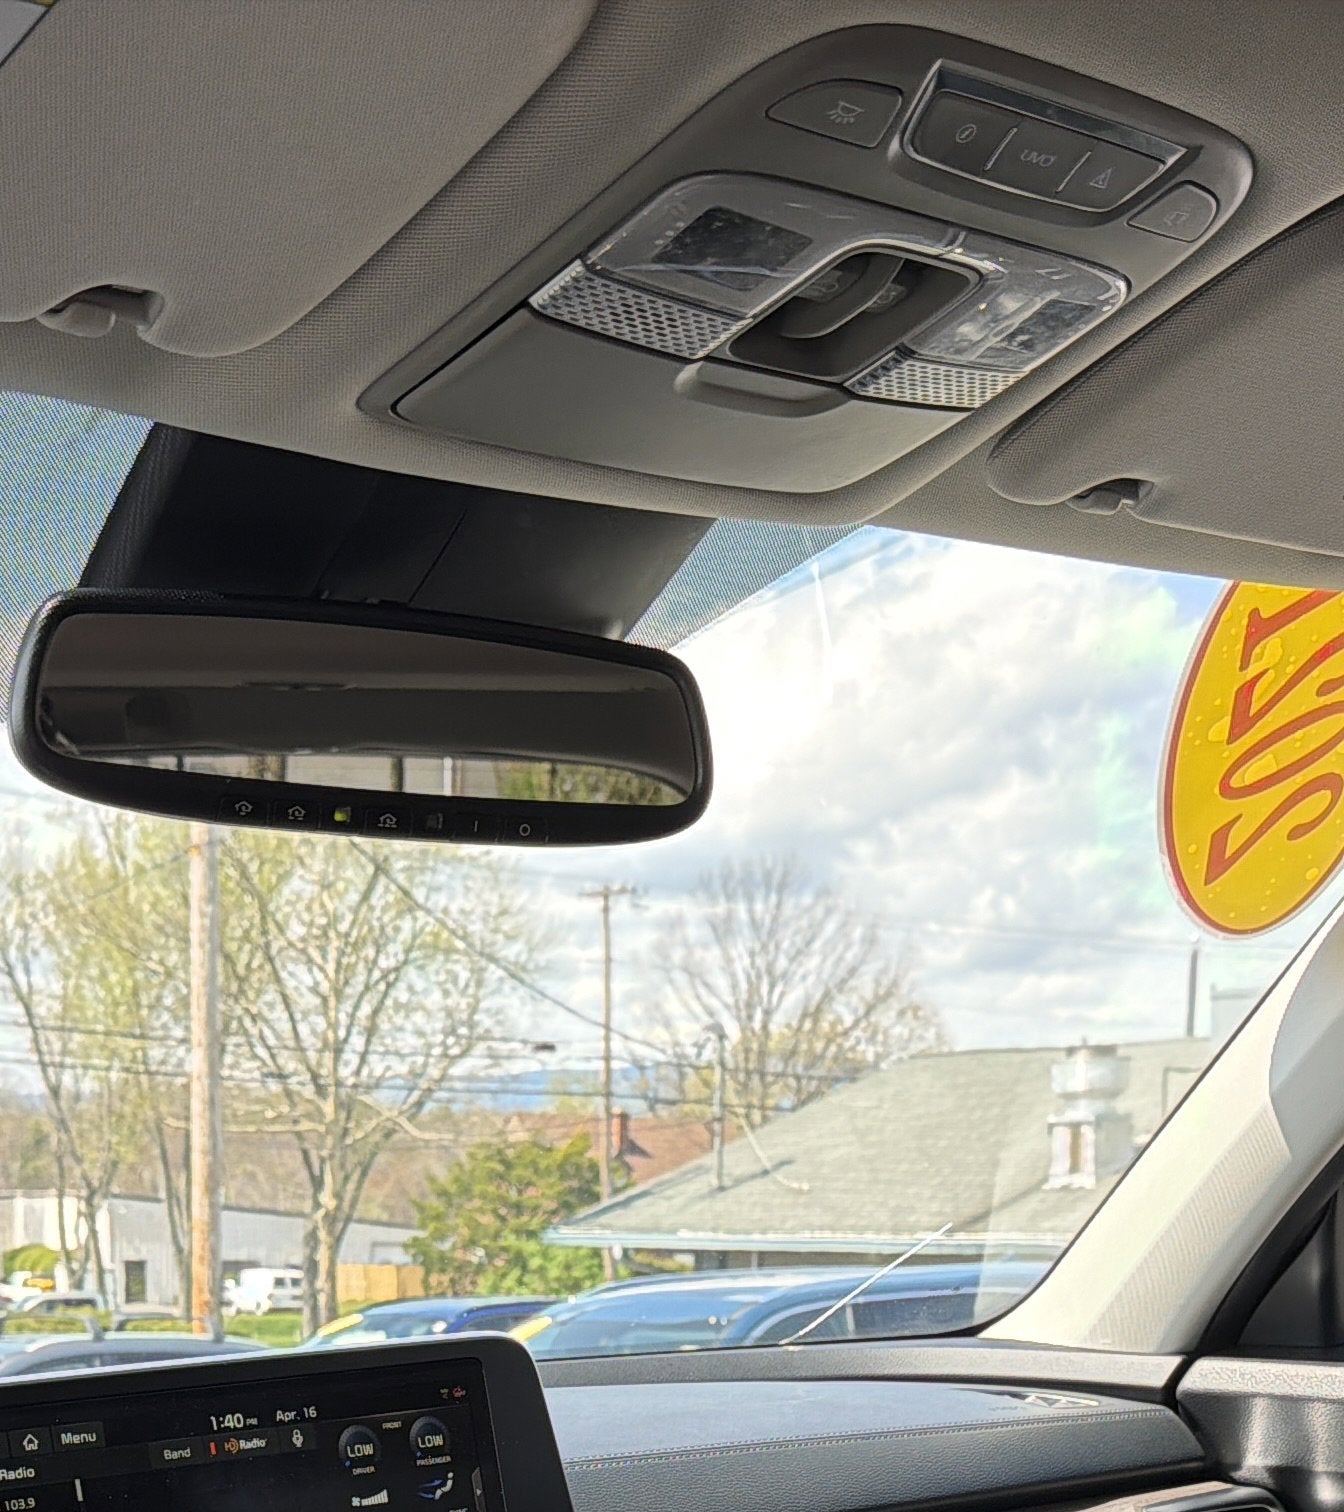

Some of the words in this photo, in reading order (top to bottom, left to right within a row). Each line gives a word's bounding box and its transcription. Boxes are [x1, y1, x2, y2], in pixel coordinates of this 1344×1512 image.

[209, 1412, 245, 1432] 1:40
[276, 1409, 301, 1424] Apr.
[303, 1405, 318, 1419] 16
[60, 1431, 97, 1445] Menu
[417, 1433, 444, 1449] LOW
[163, 1447, 192, 1460] Band
[346, 1442, 375, 1458] LOW
[4, 1497, 37, 1512] 103.9
